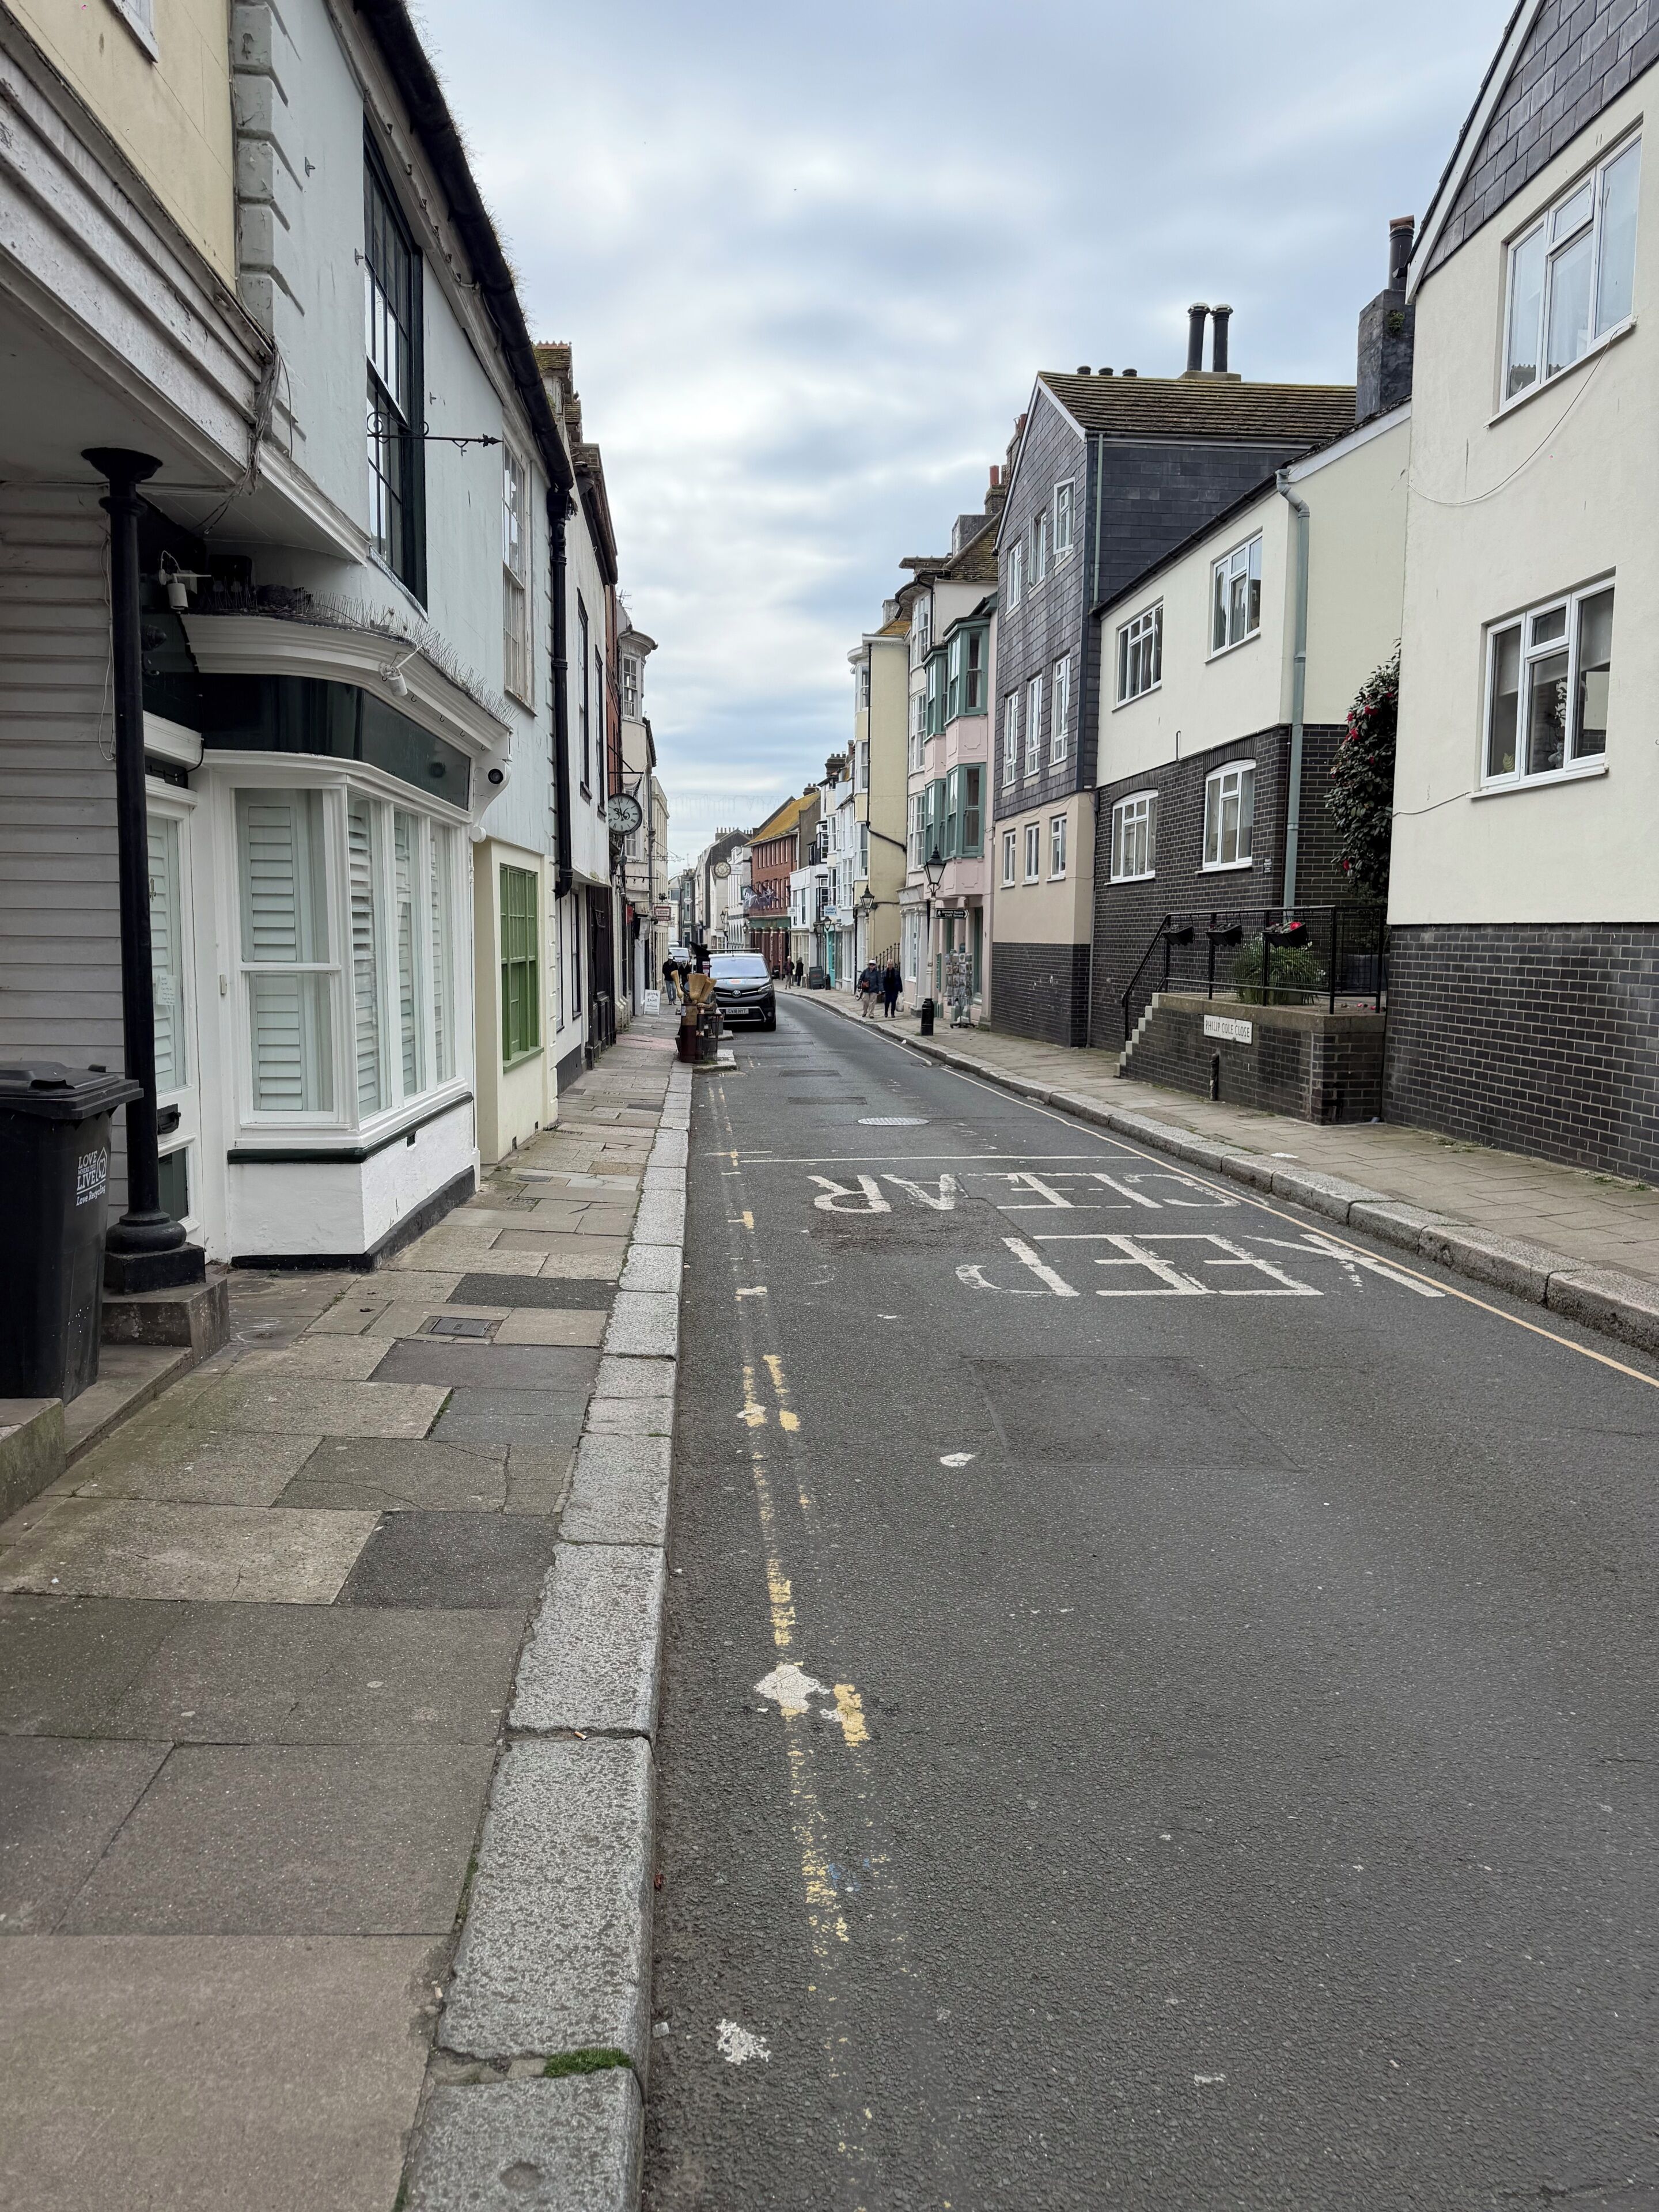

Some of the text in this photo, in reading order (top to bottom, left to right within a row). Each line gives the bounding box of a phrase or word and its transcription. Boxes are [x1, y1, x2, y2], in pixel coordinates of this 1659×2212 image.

[1205, 1020, 1250, 1037] PHILIP COLE CLOSE
[78, 1150, 98, 1169] LOVE
[77, 1170, 96, 1191] LIVE
[76, 1185, 106, 1206] Love Recycling
[806, 1171, 1241, 1214] CLEAR
[954, 1233, 1446, 1298] KEEP
